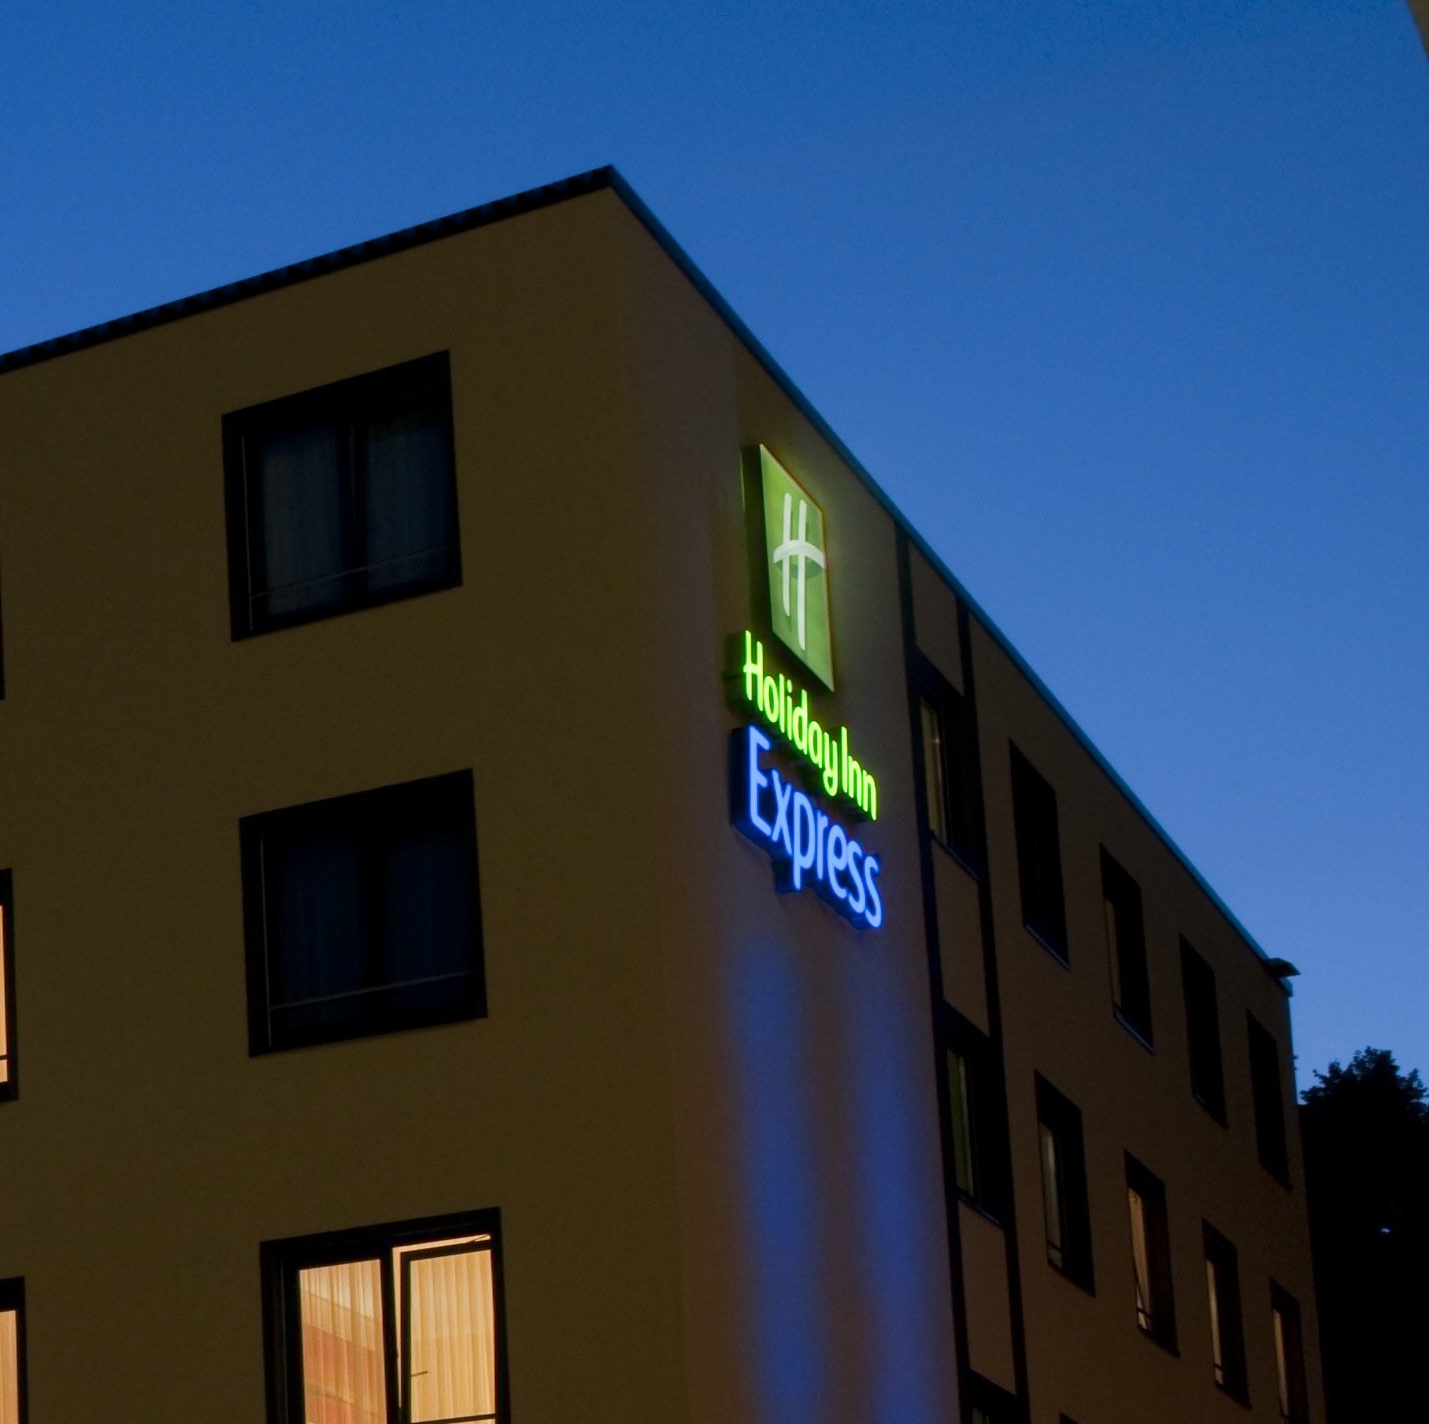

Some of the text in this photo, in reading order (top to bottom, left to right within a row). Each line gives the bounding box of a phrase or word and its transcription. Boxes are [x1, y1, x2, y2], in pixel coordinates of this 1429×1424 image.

[743, 629, 877, 822] Holiday Inn
[748, 723, 884, 929] Express
